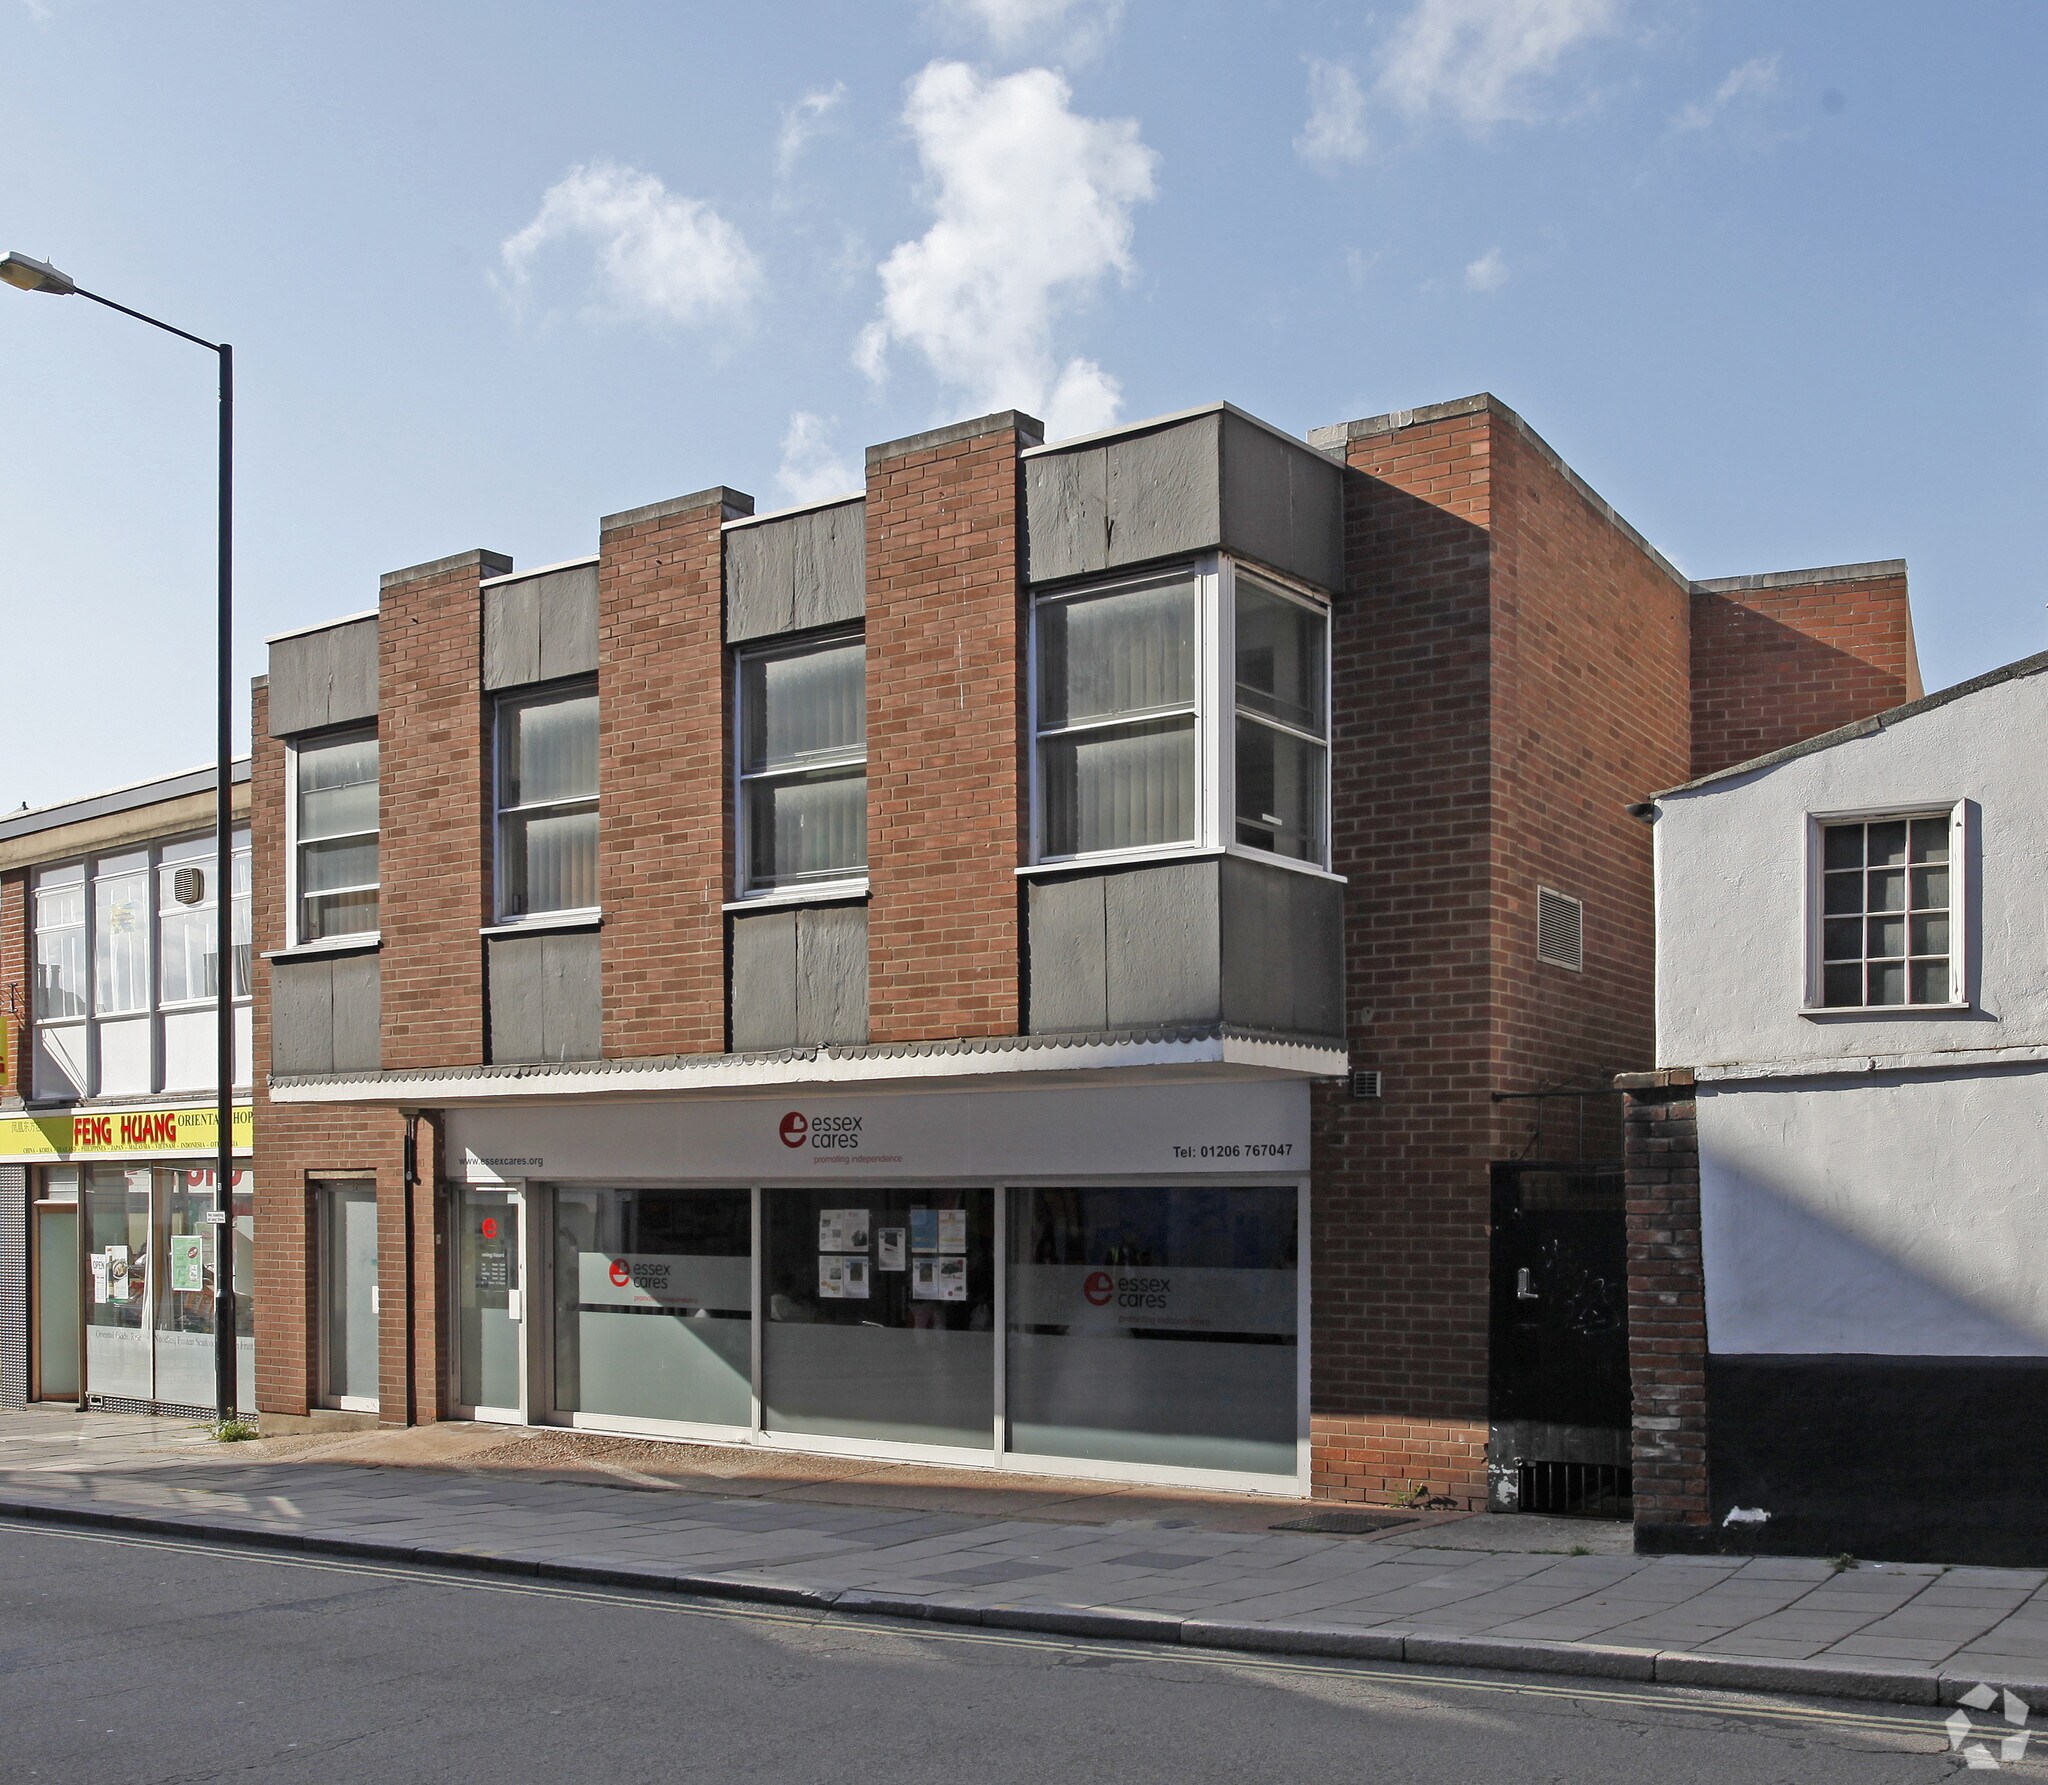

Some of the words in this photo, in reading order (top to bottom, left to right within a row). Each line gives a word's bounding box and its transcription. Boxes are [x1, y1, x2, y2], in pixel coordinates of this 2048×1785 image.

[74, 1116, 112, 1146] FENG
[120, 1113, 176, 1144] HUANG
[178, 1113, 219, 1126] ORIENTA
[233, 1111, 253, 1124] HOP
[811, 1116, 862, 1131] essex
[811, 1133, 858, 1148] cares
[1172, 1146, 1196, 1158] Tel:
[1200, 1145, 1240, 1157] 01206
[1244, 1143, 1293, 1156] 767047
[458, 1157, 543, 1168] www.essexcares.org
[813, 1155, 850, 1165] promoting
[851, 1154, 902, 1164] independence
[633, 1263, 670, 1276] essex
[633, 1277, 668, 1289] cares
[1118, 1277, 1171, 1292] essex
[1118, 1293, 1167, 1309] cares
